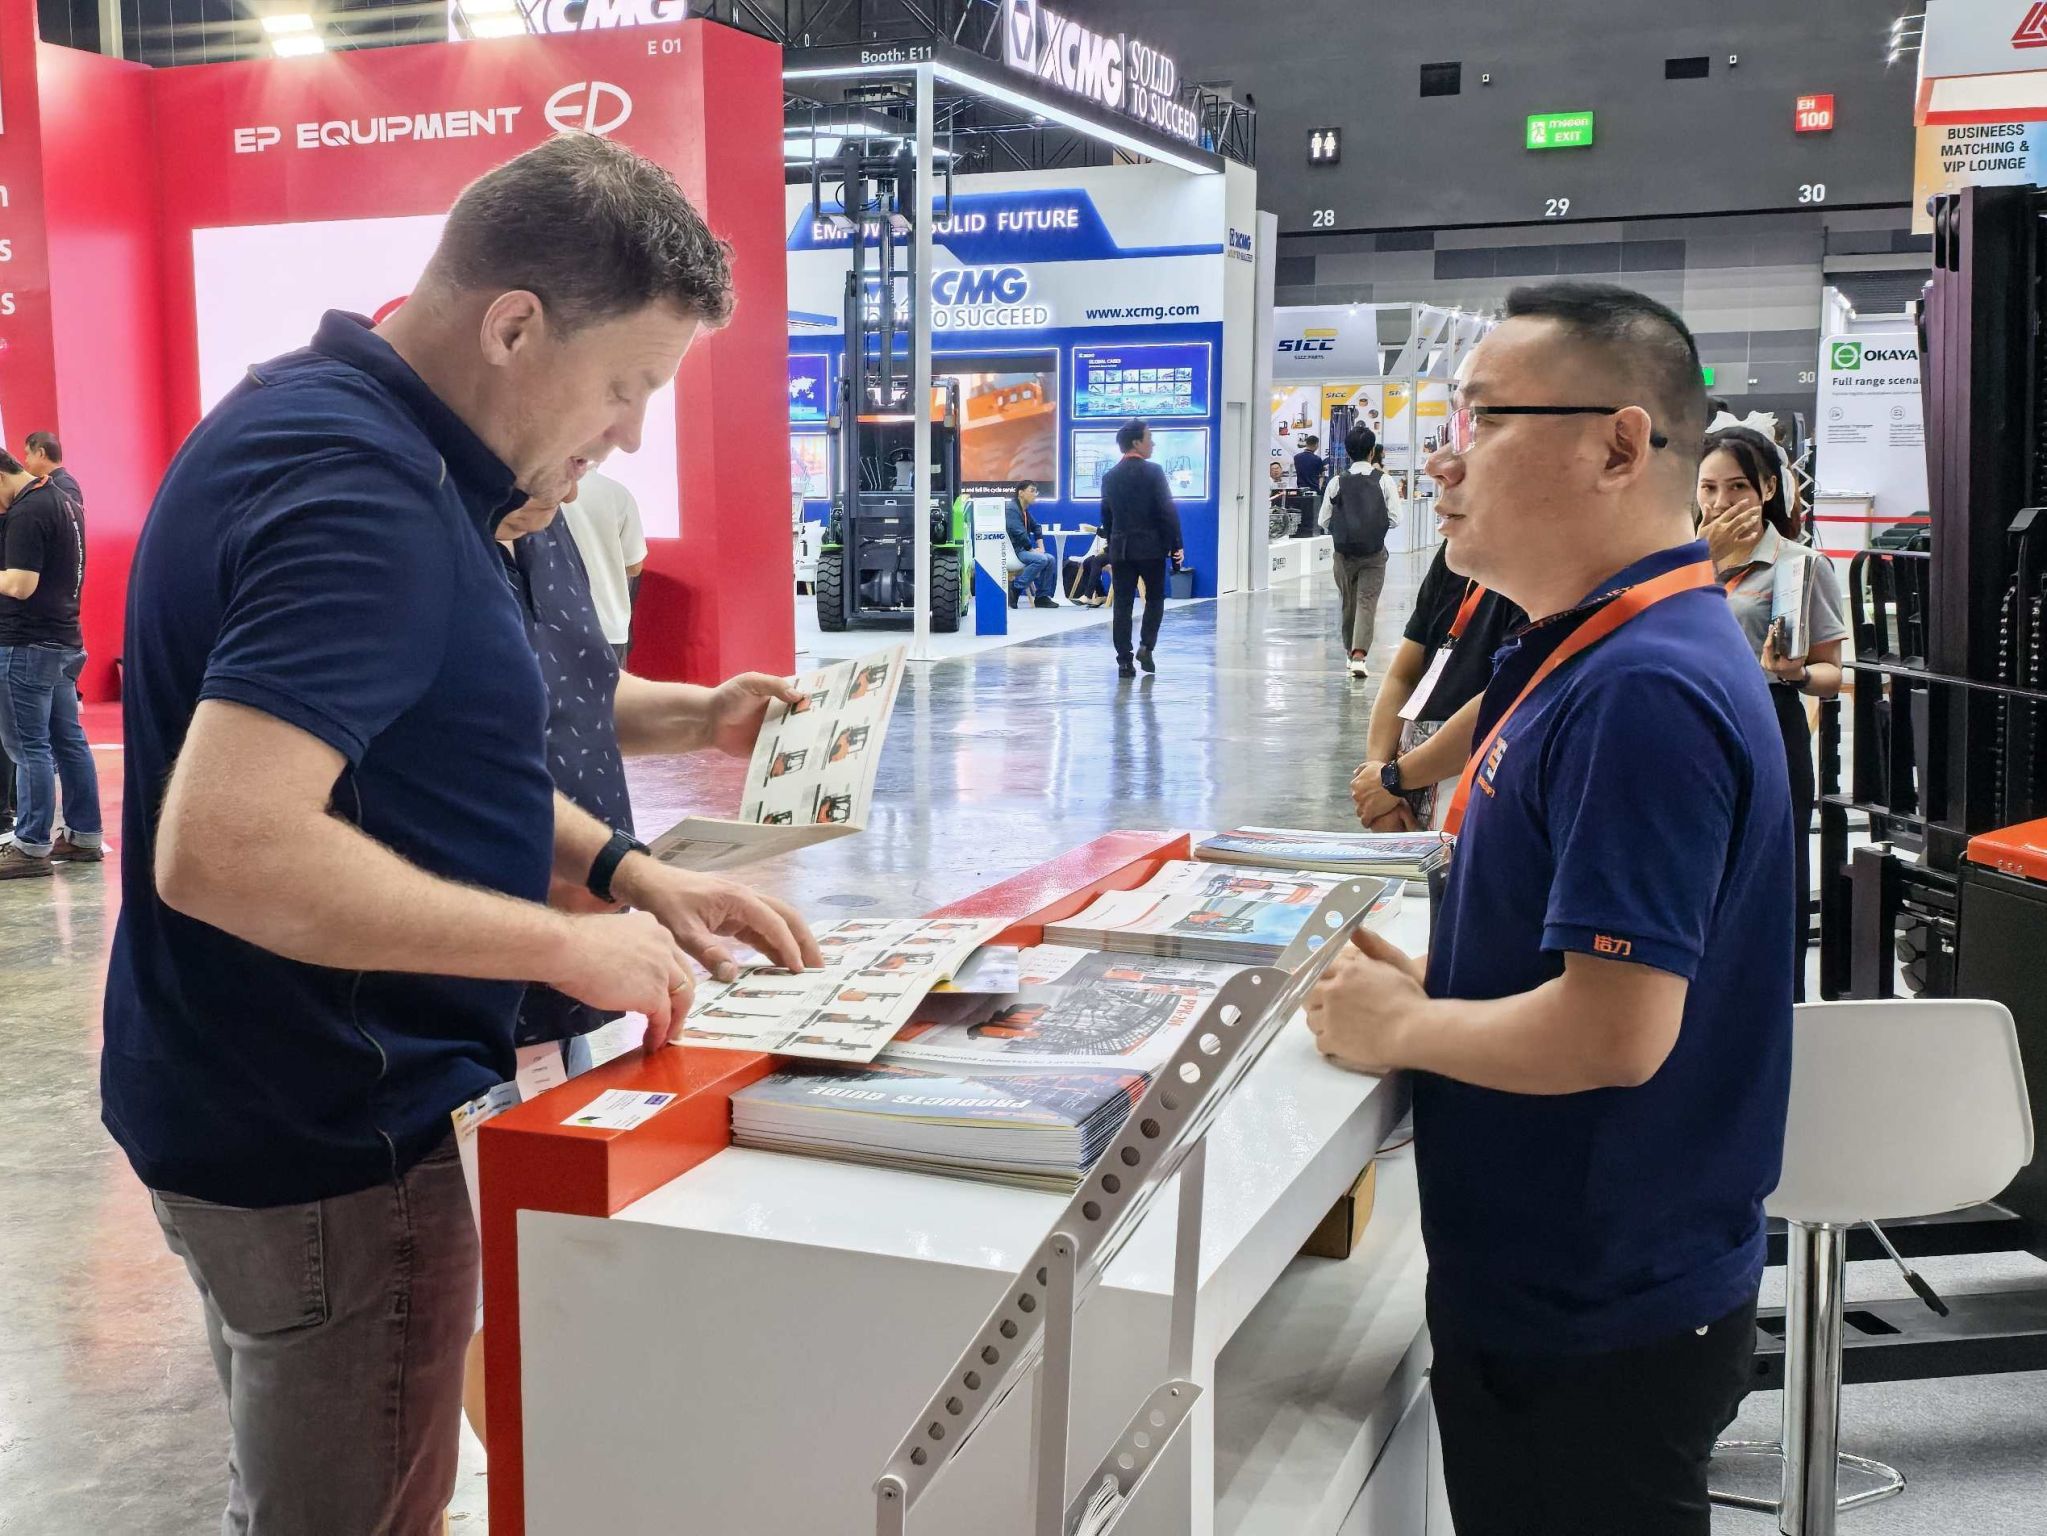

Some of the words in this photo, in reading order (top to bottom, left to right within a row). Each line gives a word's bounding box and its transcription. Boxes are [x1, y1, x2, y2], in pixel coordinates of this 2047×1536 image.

[648, 41, 657, 55] E
[662, 38, 681, 54] 01
[861, 48, 905, 63] Booth:
[909, 46, 932, 60] E11
[1038, 9, 1123, 107] XCMG
[1130, 40, 1175, 97] SOLID
[1132, 84, 1148, 118] TO
[1150, 94, 1197, 140] SUCCEED
[1798, 99, 1815, 110] EH
[1800, 111, 1829, 127] 100
[234, 126, 281, 153] EP
[296, 106, 522, 149] EQUIPMENT
[1555, 131, 1581, 142] EXIT
[1947, 124, 2025, 139] BUSINEESS
[1941, 141, 2014, 156] MATCHING
[2019, 140, 2030, 152] &
[1943, 161, 1966, 173] VIP
[1969, 157, 2026, 171] LOUNGE
[1798, 184, 1826, 203] 30
[1545, 198, 1570, 216] 29
[931, 213, 985, 235] OLID
[998, 209, 1079, 231] FUTURE
[1312, 210, 1335, 227] 28
[931, 267, 1028, 306] CMG
[956, 307, 1047, 327] SUCCEED
[1086, 305, 1199, 320] www.xcmg.com
[1277, 338, 1336, 351] SICC
[1864, 350, 1918, 361] OKAYA
[1798, 371, 1816, 383] 30
[1832, 377, 1852, 386] Full
[1855, 378, 1886, 387] range
[1888, 377, 1921, 385] scena
[808, 1086, 887, 1100] GUIDE
[892, 1095, 1031, 1109] PRODUCTS
